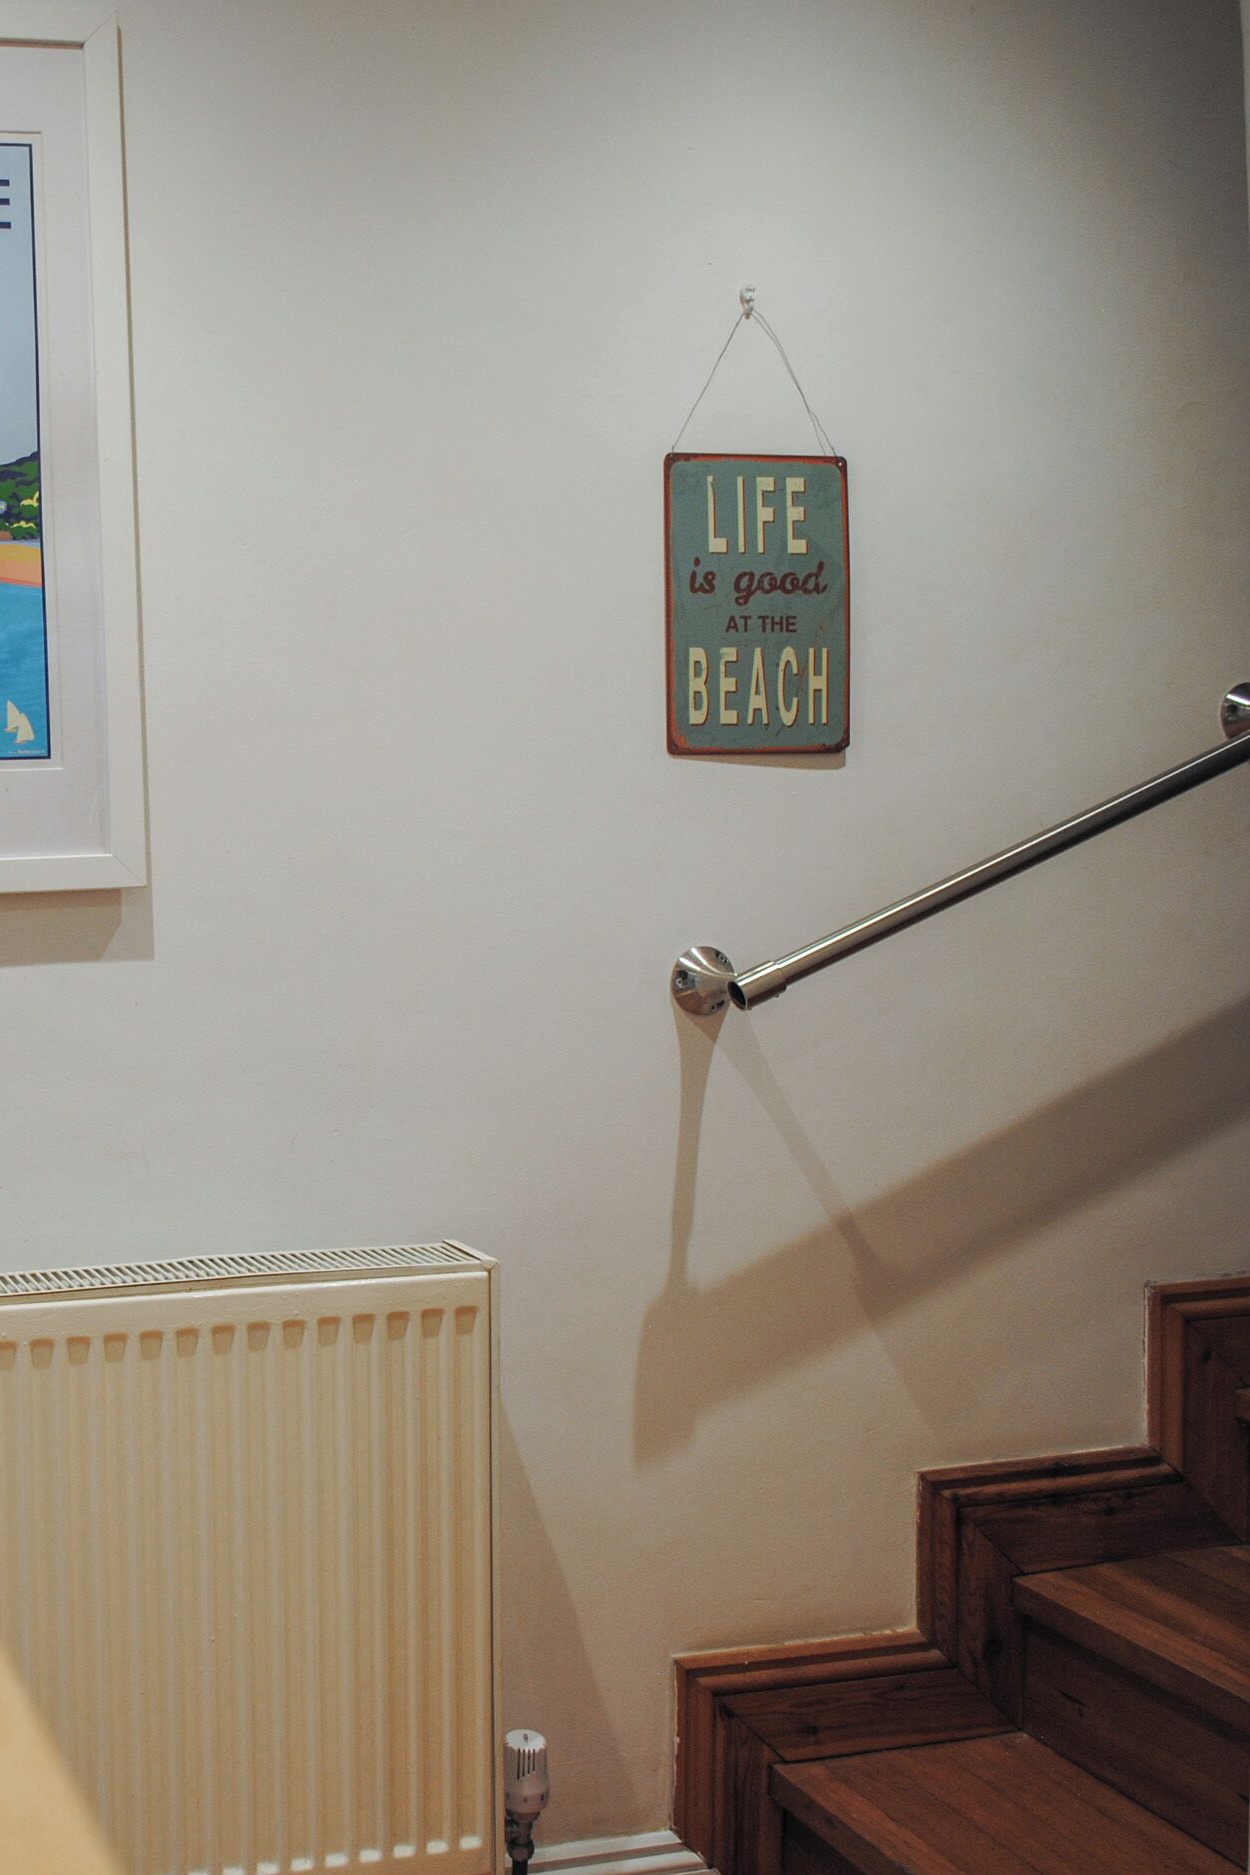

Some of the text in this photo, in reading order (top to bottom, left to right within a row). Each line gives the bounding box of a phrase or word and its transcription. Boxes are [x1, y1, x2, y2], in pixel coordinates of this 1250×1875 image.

[707, 475, 809, 554] LIFE
[689, 556, 828, 606] is good
[725, 615, 797, 633] AT THE
[689, 646, 828, 727] BEACH
